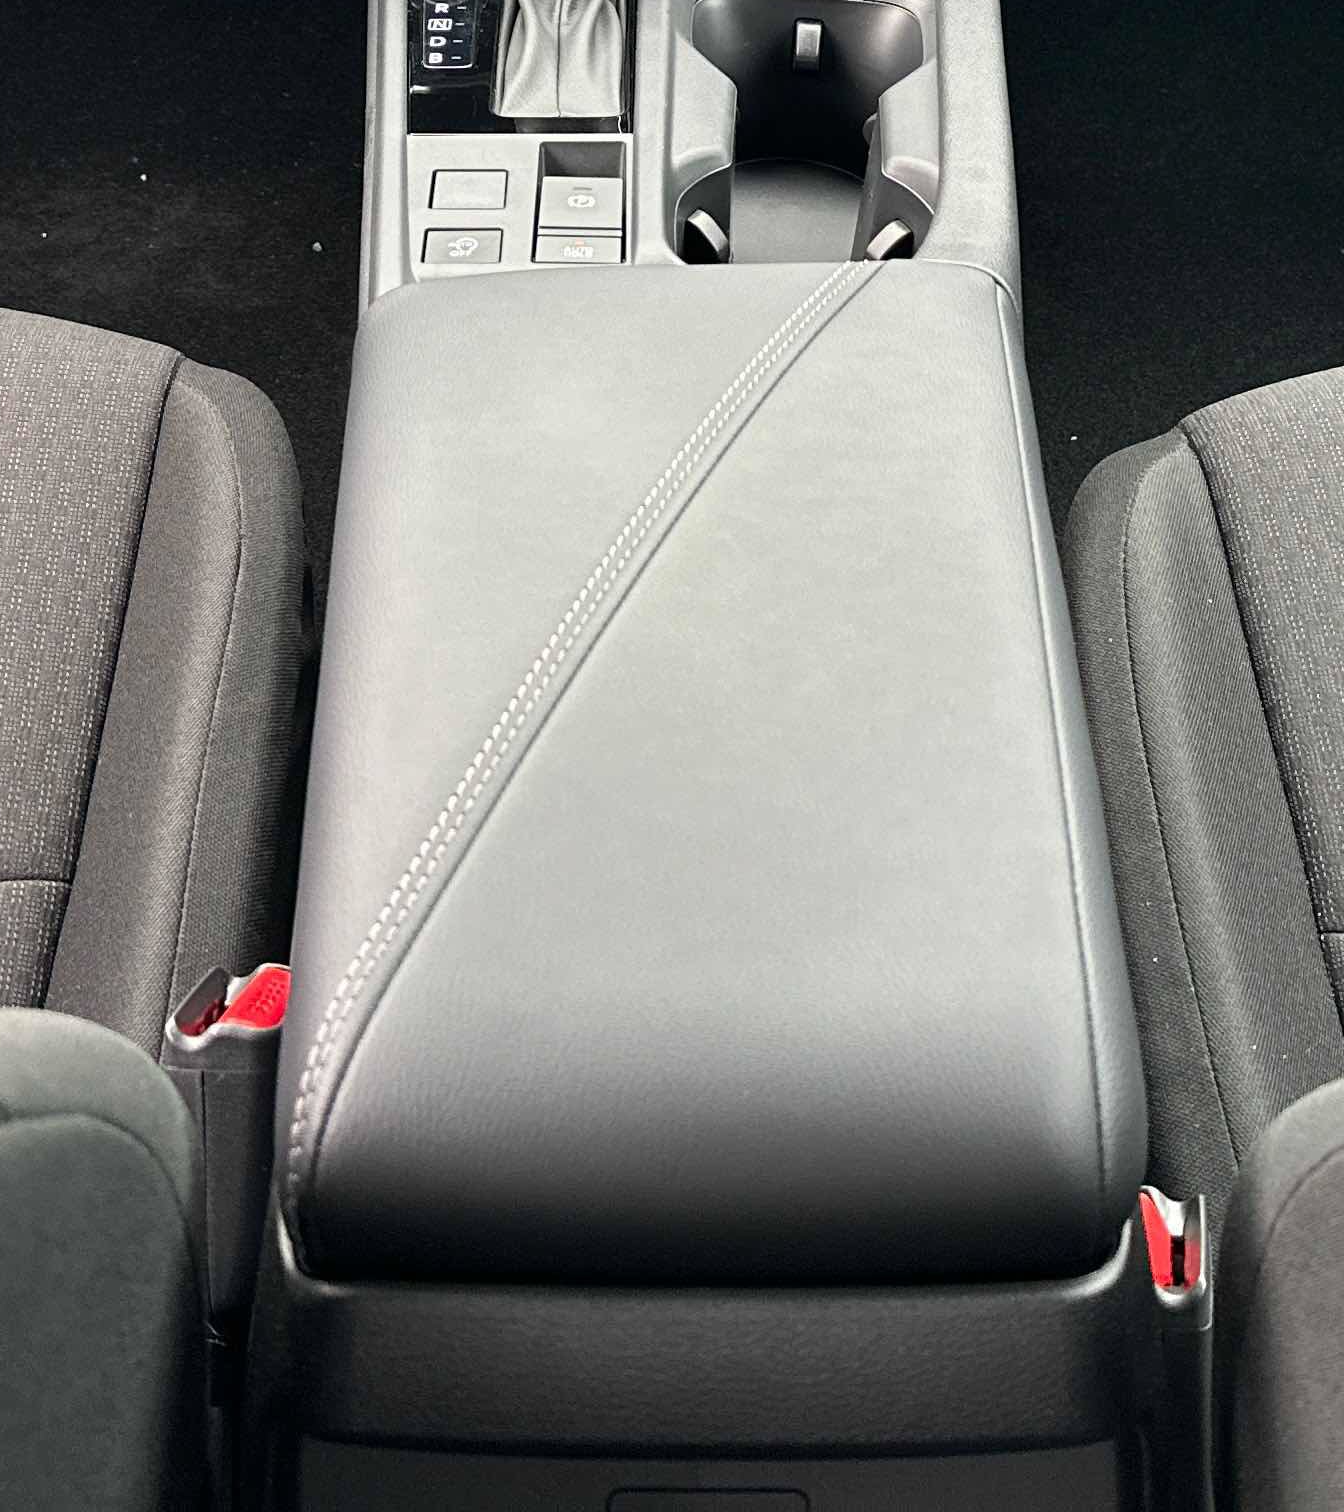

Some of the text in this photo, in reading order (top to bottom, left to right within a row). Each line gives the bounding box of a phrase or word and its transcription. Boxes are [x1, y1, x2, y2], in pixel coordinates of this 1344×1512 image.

[434, 2, 449, 13] R
[429, 36, 447, 47] D
[428, 52, 443, 64] B
